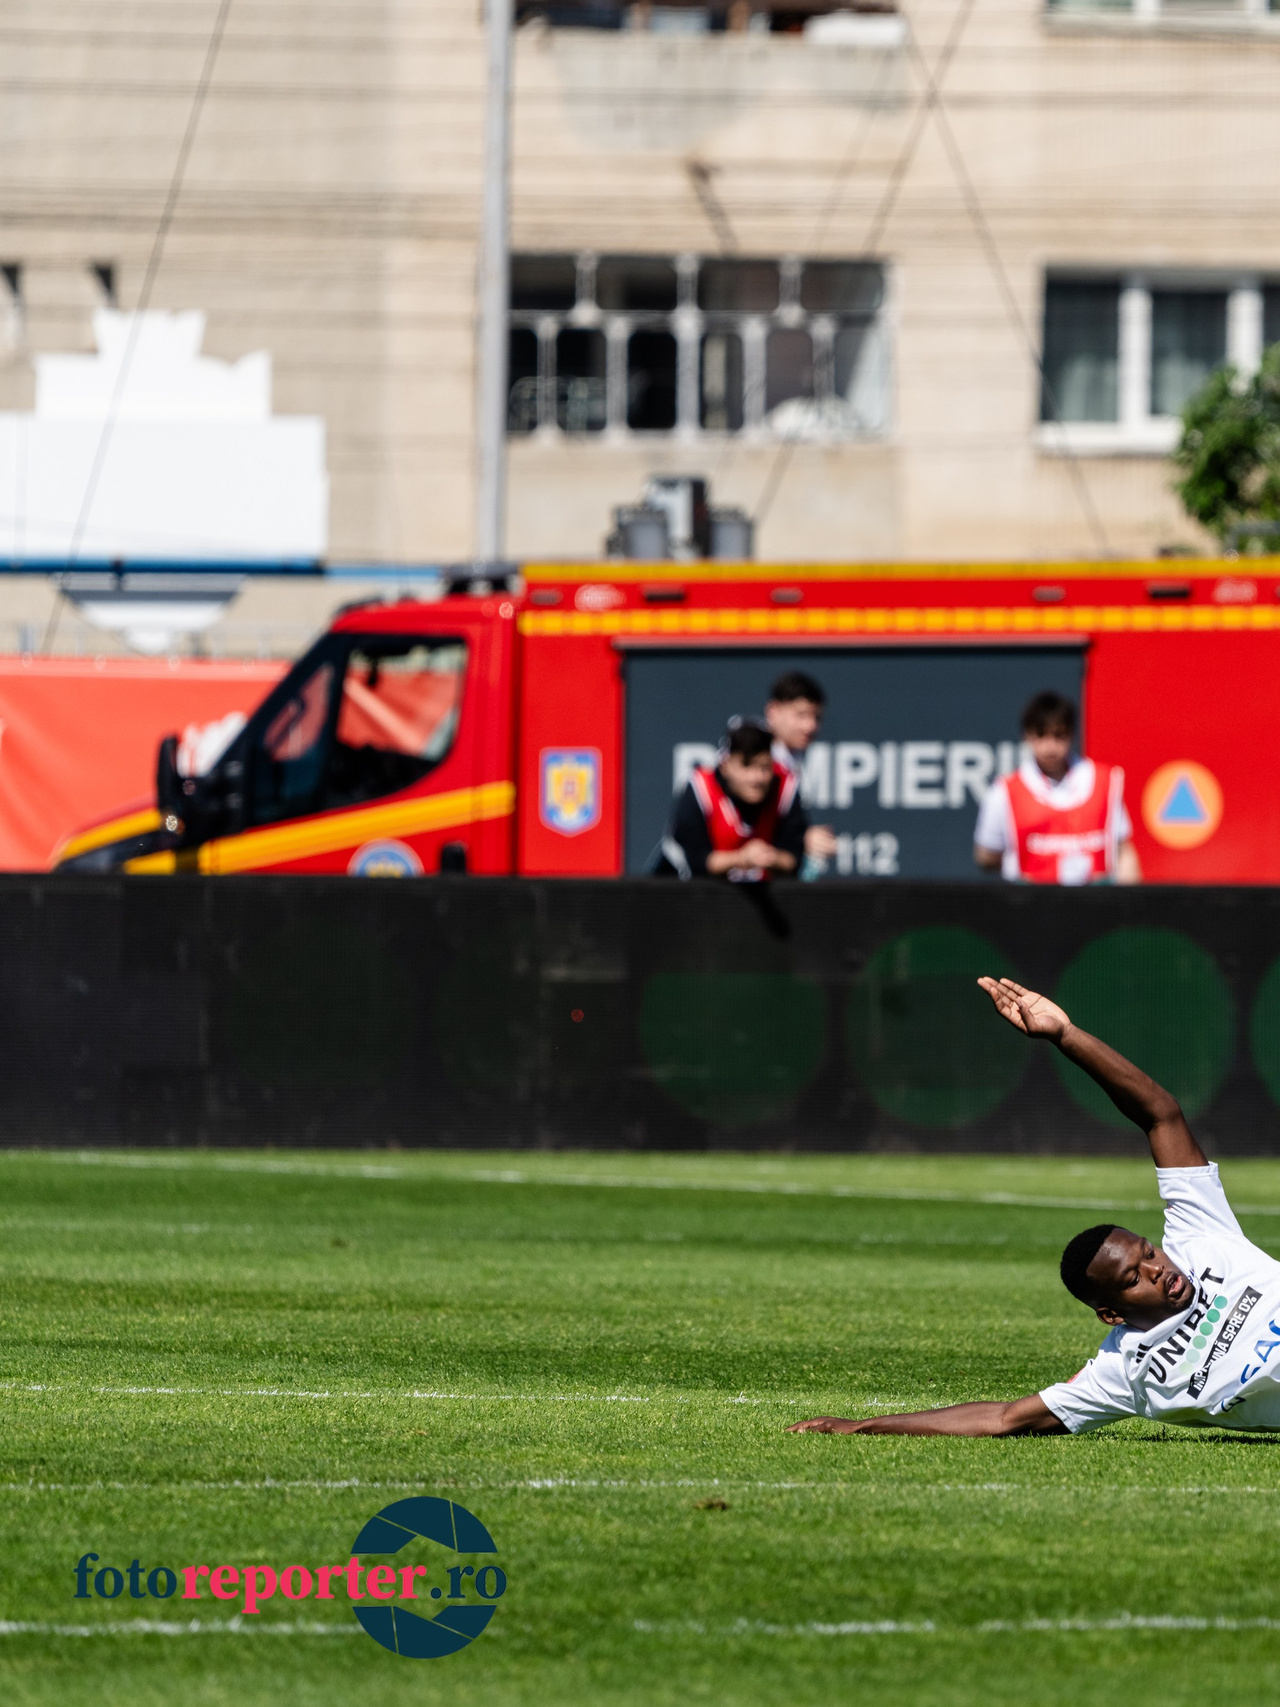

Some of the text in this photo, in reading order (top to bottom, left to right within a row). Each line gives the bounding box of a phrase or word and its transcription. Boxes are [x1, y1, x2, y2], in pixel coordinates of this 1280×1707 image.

[672, 741, 1033, 810] PMPIERI
[1149, 1267, 1224, 1384] UNIBET
[1222, 1312, 1246, 1342] SPRE
[1239, 1294, 1257, 1313] 0%
